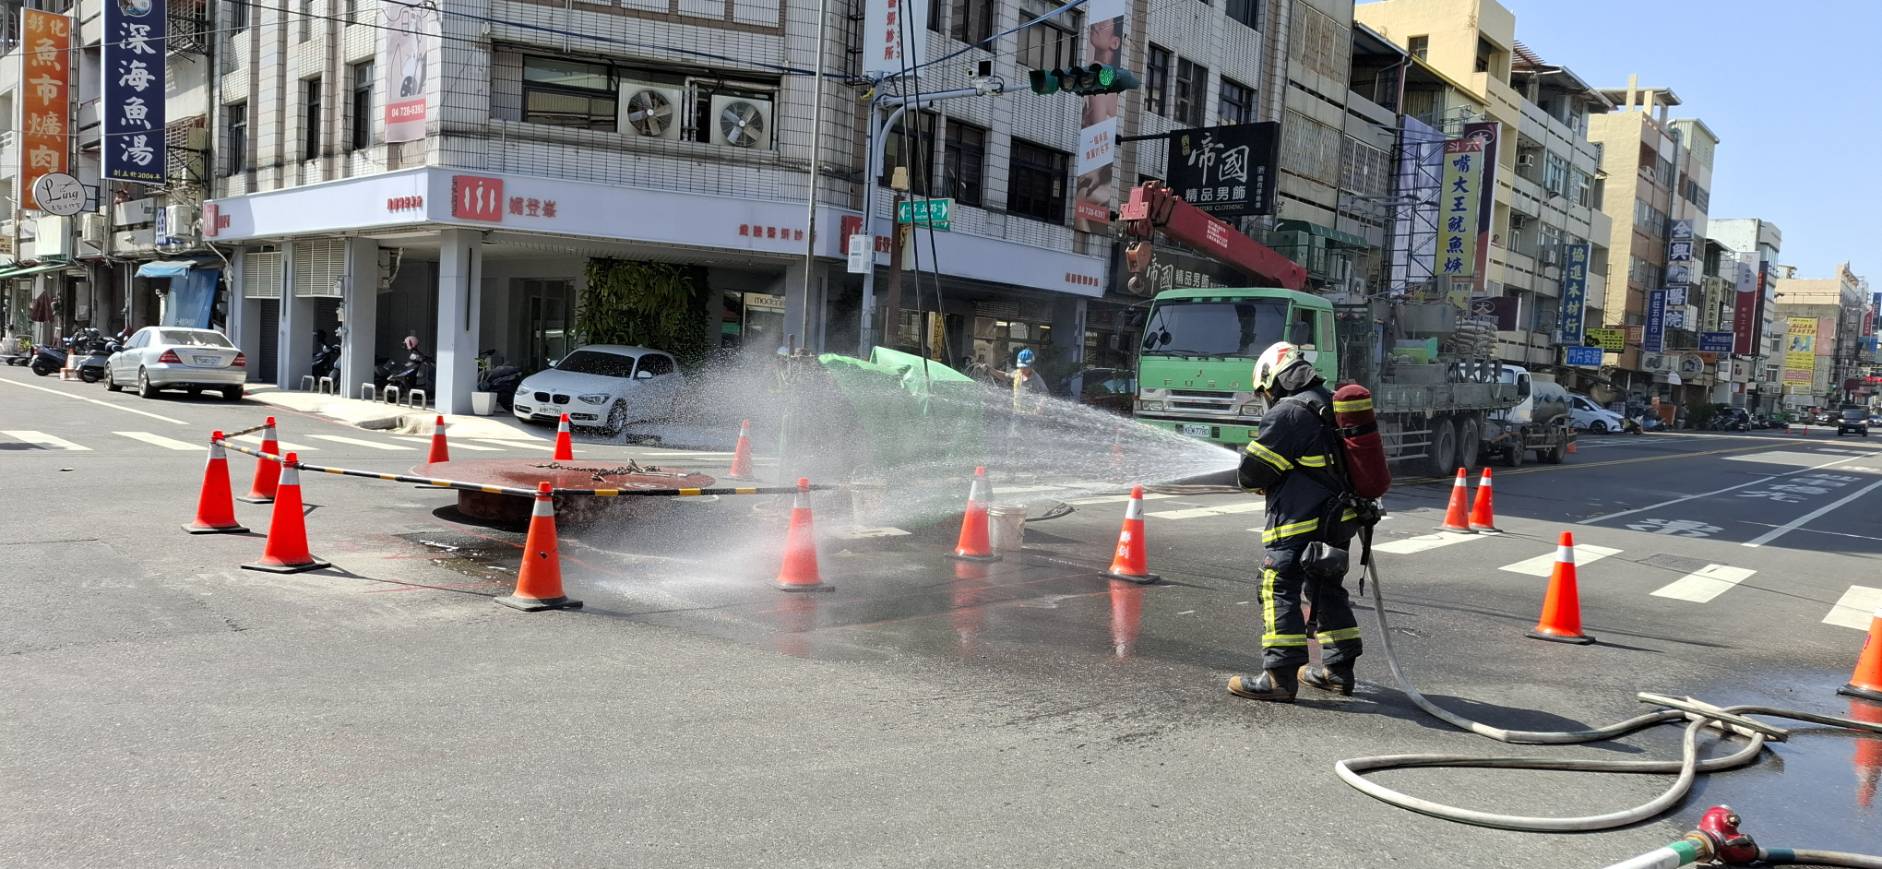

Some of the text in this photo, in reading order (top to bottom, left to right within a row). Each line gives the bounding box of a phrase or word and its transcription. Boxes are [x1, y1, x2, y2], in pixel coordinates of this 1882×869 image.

[27, 15, 67, 38] 彰化
[118, 22, 156, 167] 深海魚湯
[28, 39, 63, 190] 魚市爌肉
[1188, 132, 1249, 186] 帝國
[1448, 141, 1480, 152] 斗六
[1185, 185, 1246, 202] 精品男飾
[1146, 253, 1174, 294] 帝國
[1175, 269, 1210, 289] 精品男飾
